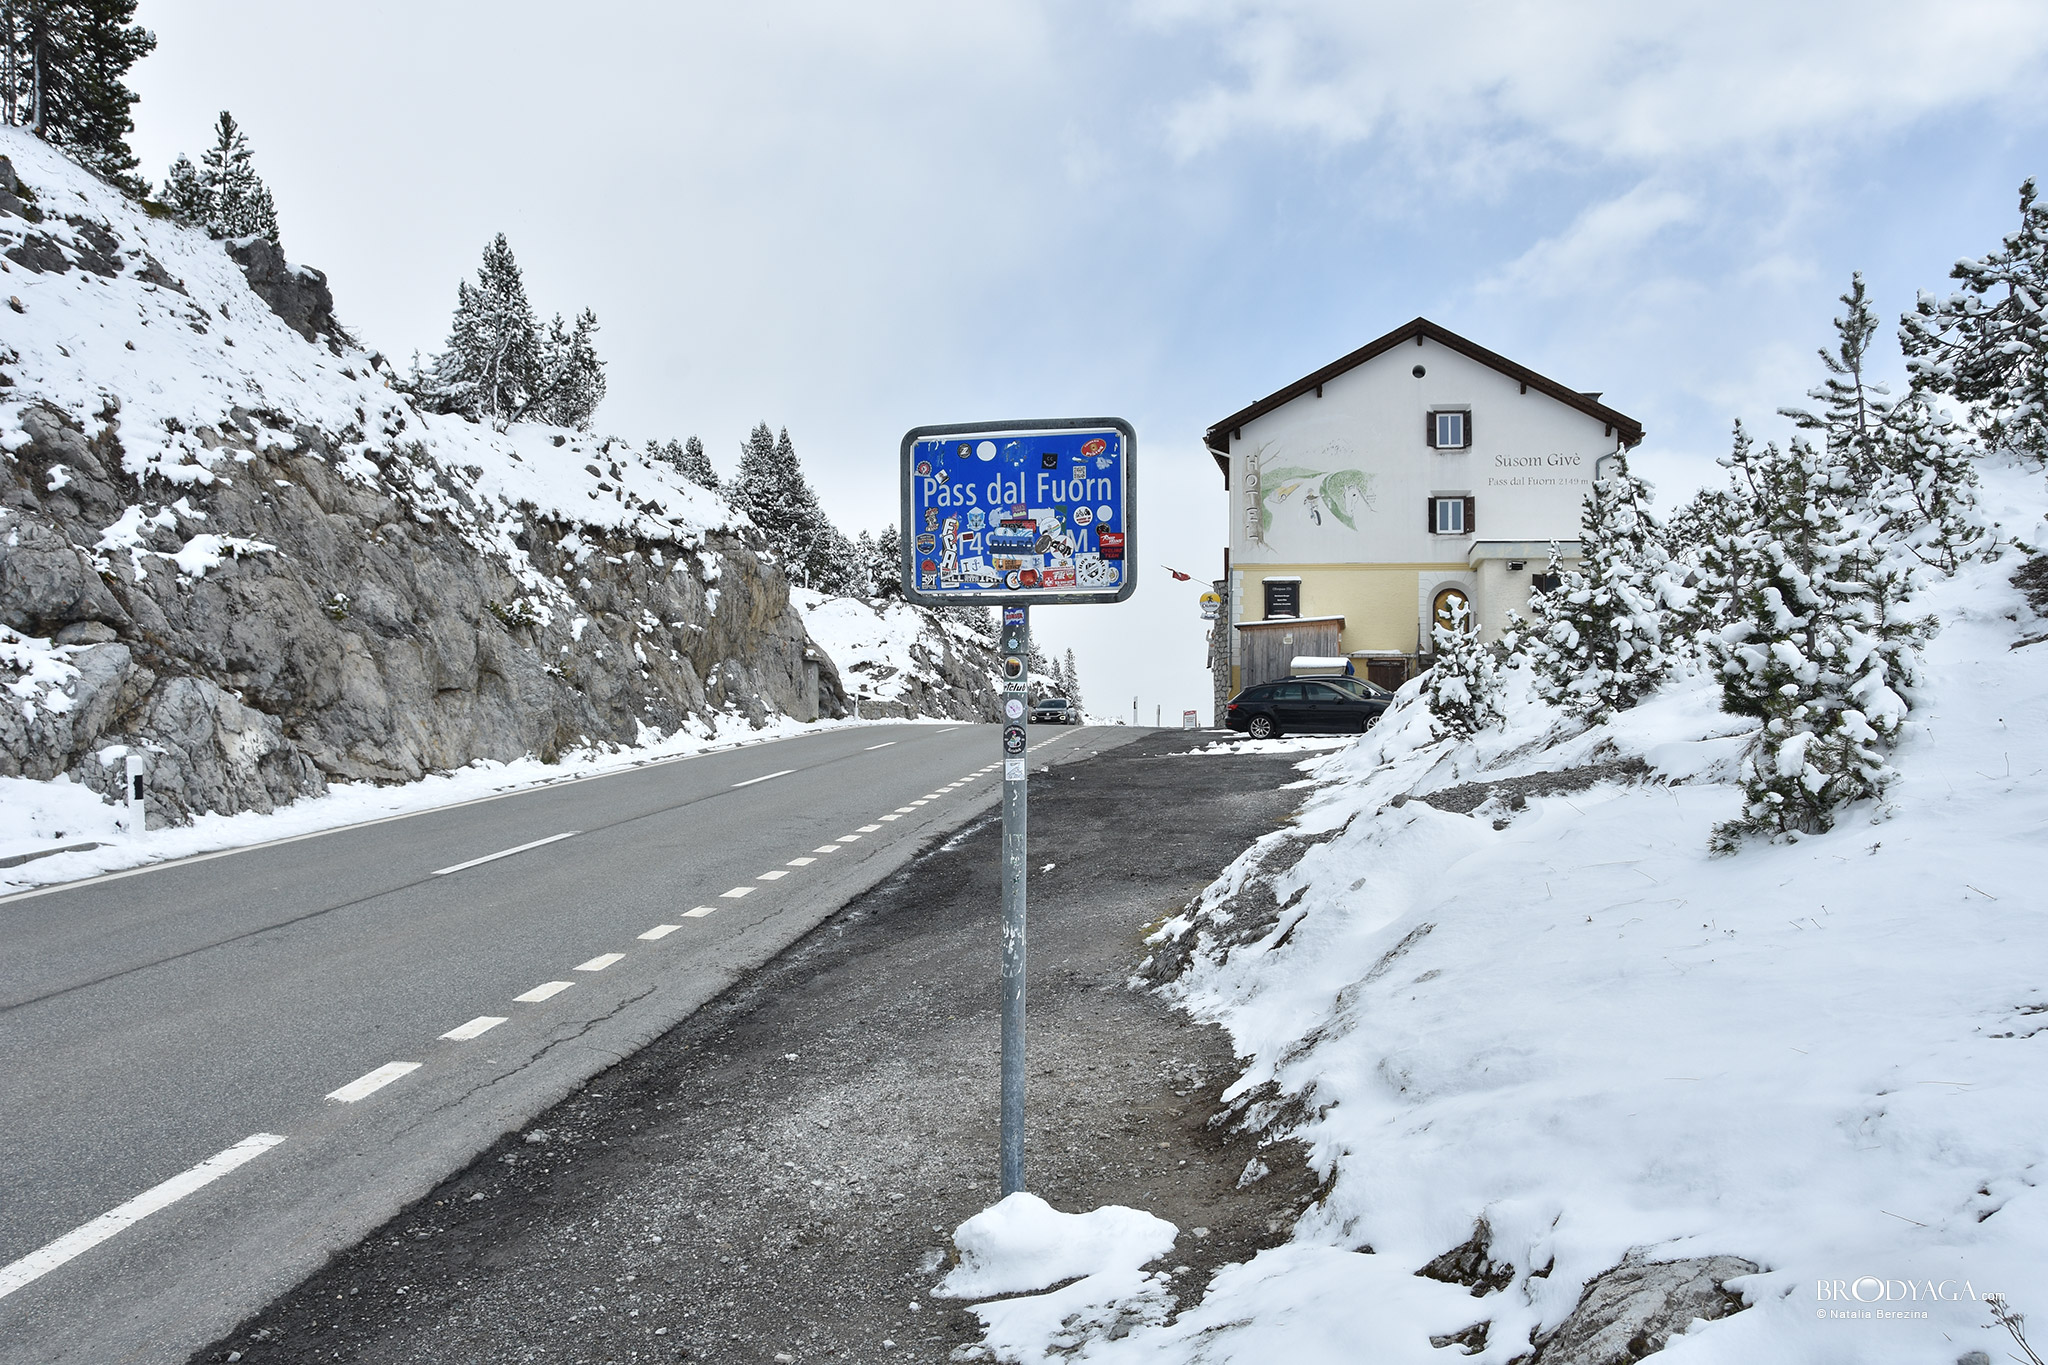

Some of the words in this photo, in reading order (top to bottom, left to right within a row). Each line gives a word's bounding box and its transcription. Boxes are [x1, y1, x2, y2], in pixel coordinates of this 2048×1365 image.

[1495, 454, 1542, 467] Süsom
[1547, 453, 1581, 466] Givè
[924, 478, 977, 507] Pass
[987, 472, 1026, 504] dal
[1037, 472, 1112, 503] Fuorn
[1488, 477, 1508, 486] Pass
[1510, 477, 1525, 485] dal
[1528, 477, 1556, 486] Fuorn
[1245, 455, 1259, 540] HOTEL
